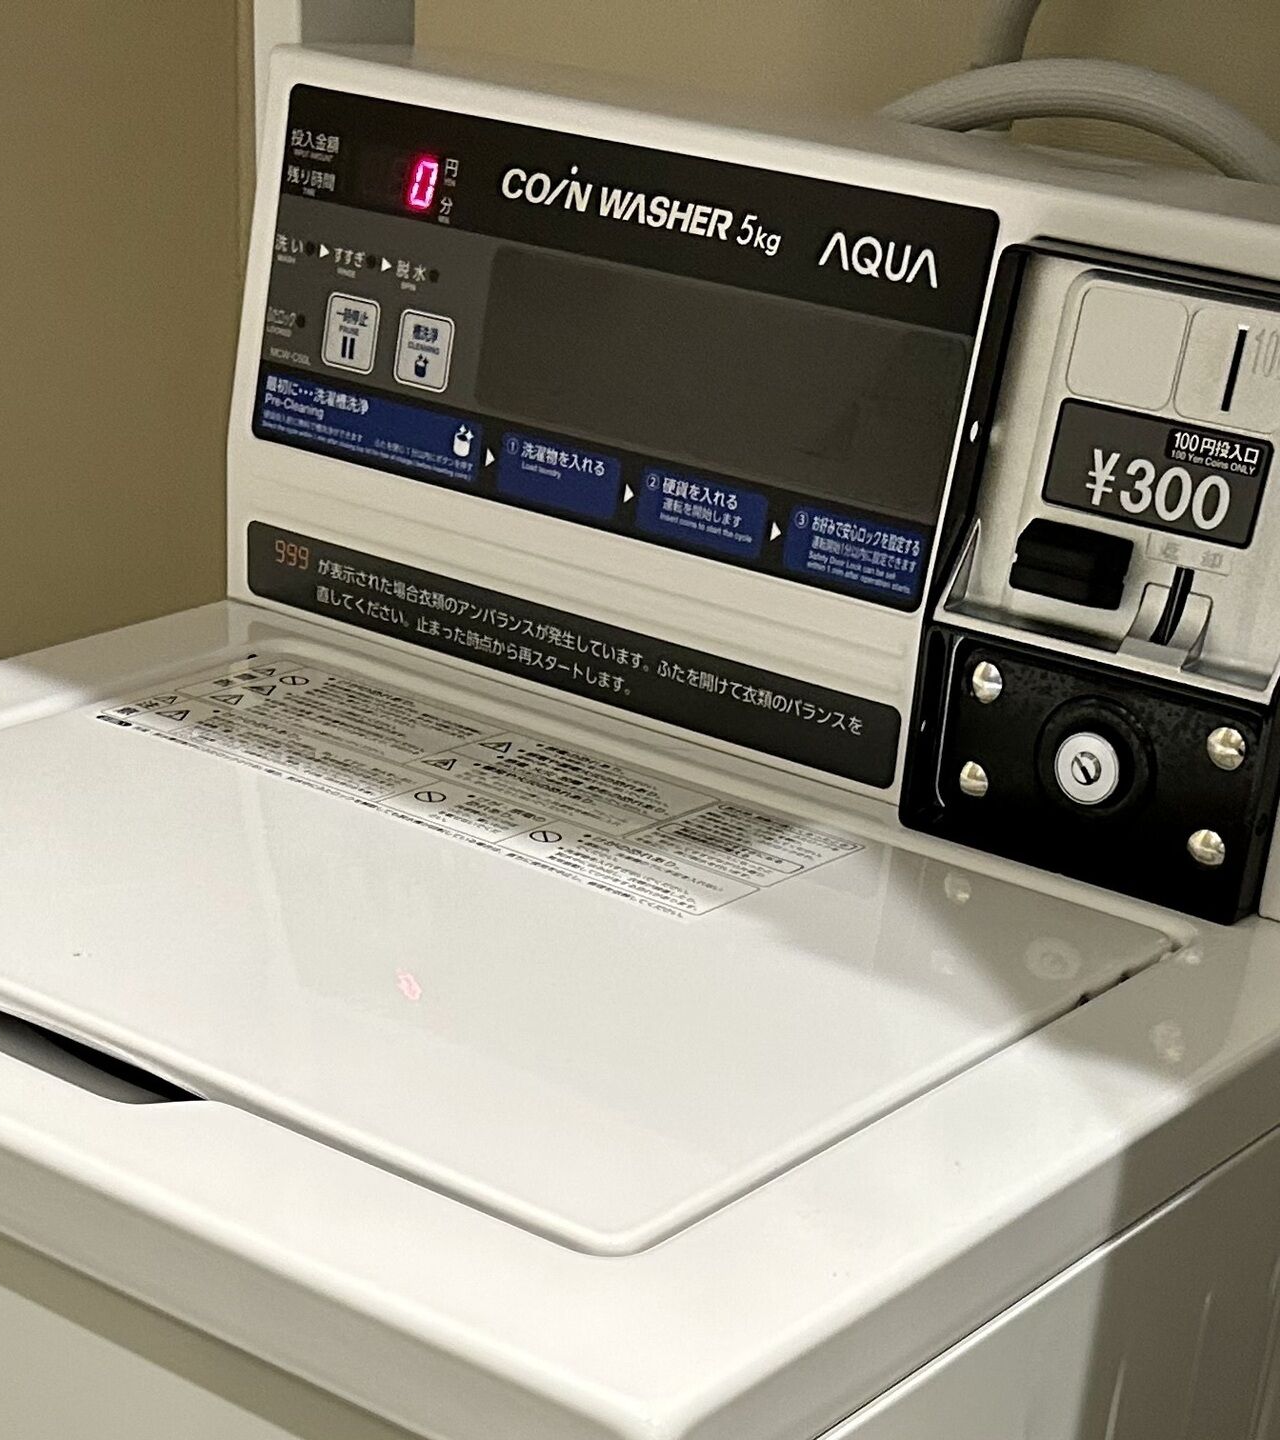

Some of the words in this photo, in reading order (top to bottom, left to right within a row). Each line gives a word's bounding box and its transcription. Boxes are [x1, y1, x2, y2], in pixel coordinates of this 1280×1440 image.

[291, 128, 340, 153] 投入金額
[287, 164, 336, 192] 残り時間
[445, 158, 459, 178] 円
[409, 159, 439, 209] 0
[439, 197, 453, 215] 分
[501, 165, 593, 212] COIN
[598, 186, 734, 241] WASHER
[736, 214, 782, 257] 5kg
[334, 248, 365, 268] すすぎ
[396, 260, 427, 282] 脱水
[819, 232, 938, 289] AQUA
[521, 441, 605, 476] 洗濯物を入れる
[1171, 450, 1186, 461] 100
[1188, 453, 1204, 466] Yen
[1204, 456, 1229, 471] Coins
[1230, 462, 1256, 475] ONLY
[1174, 431, 1260, 465] 100円投入口
[662, 478, 738, 510] 硬貨を入れる
[1085, 448, 1230, 531] ¥300
[662, 498, 742, 528] 運転を開始します
[274, 540, 309, 570] 999
